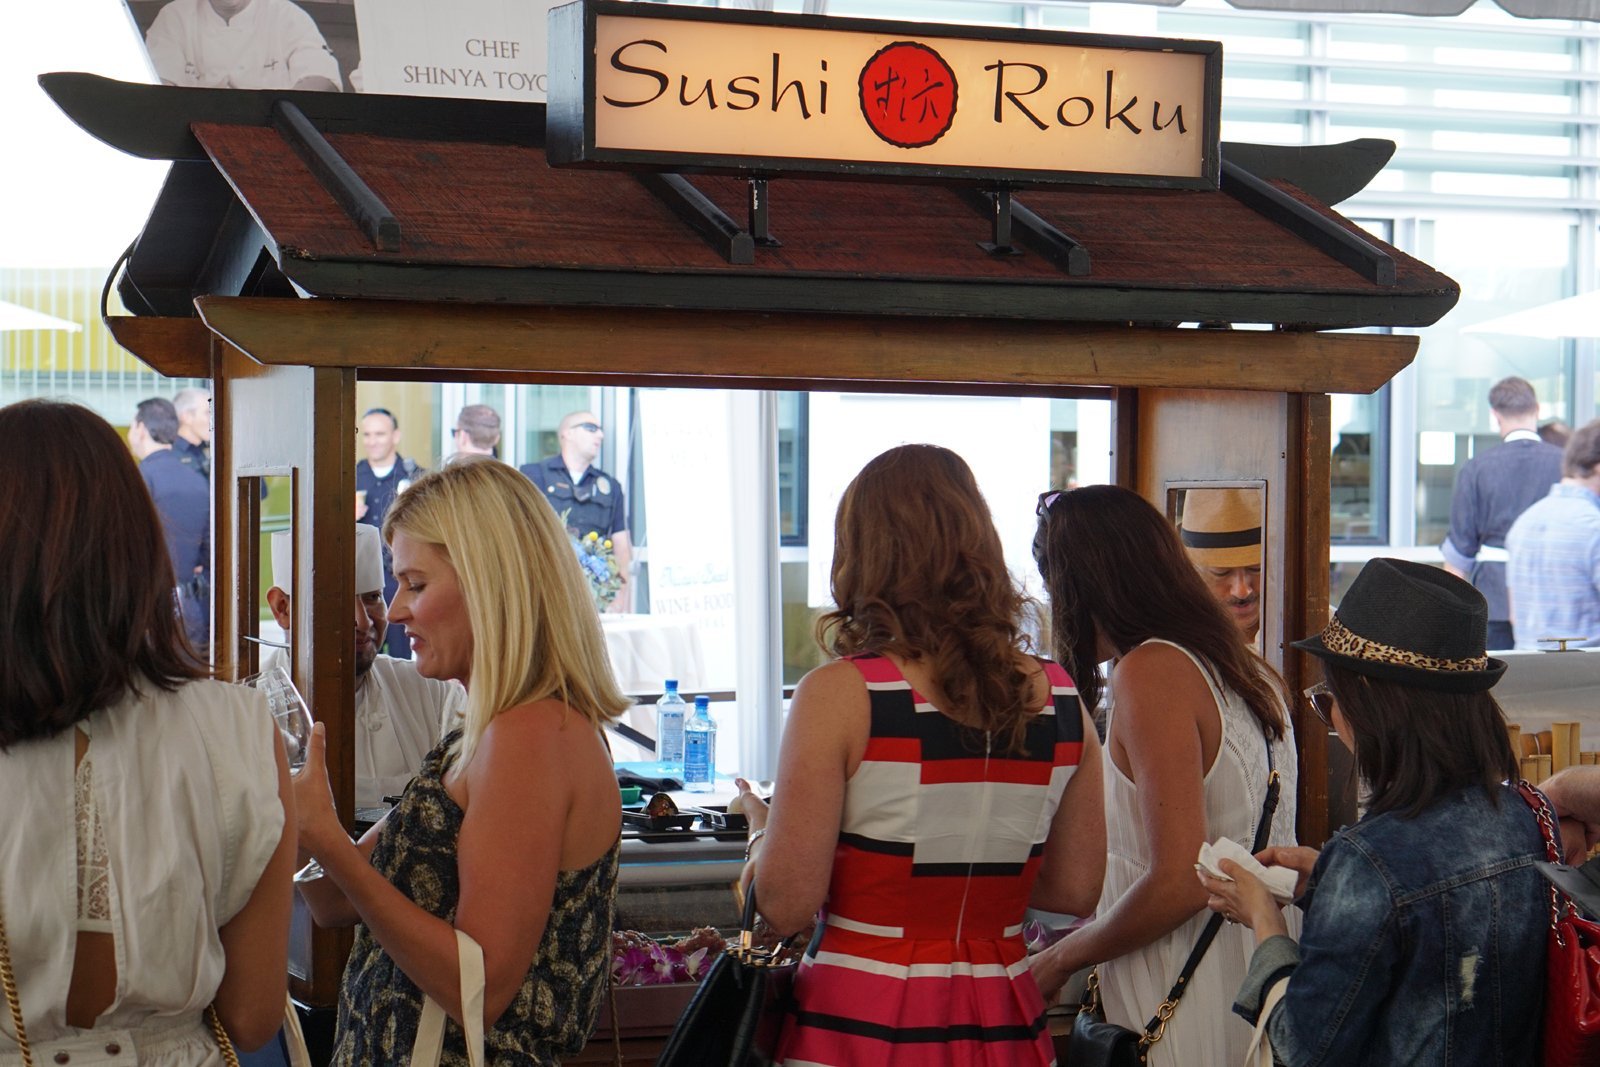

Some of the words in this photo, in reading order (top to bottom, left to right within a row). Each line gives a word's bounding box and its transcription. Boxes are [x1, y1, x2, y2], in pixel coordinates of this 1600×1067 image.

[465, 38, 520, 59] CHEF
[403, 65, 487, 88] SHINYA
[602, 39, 828, 120] Sushi
[984, 59, 1188, 135] Roku
